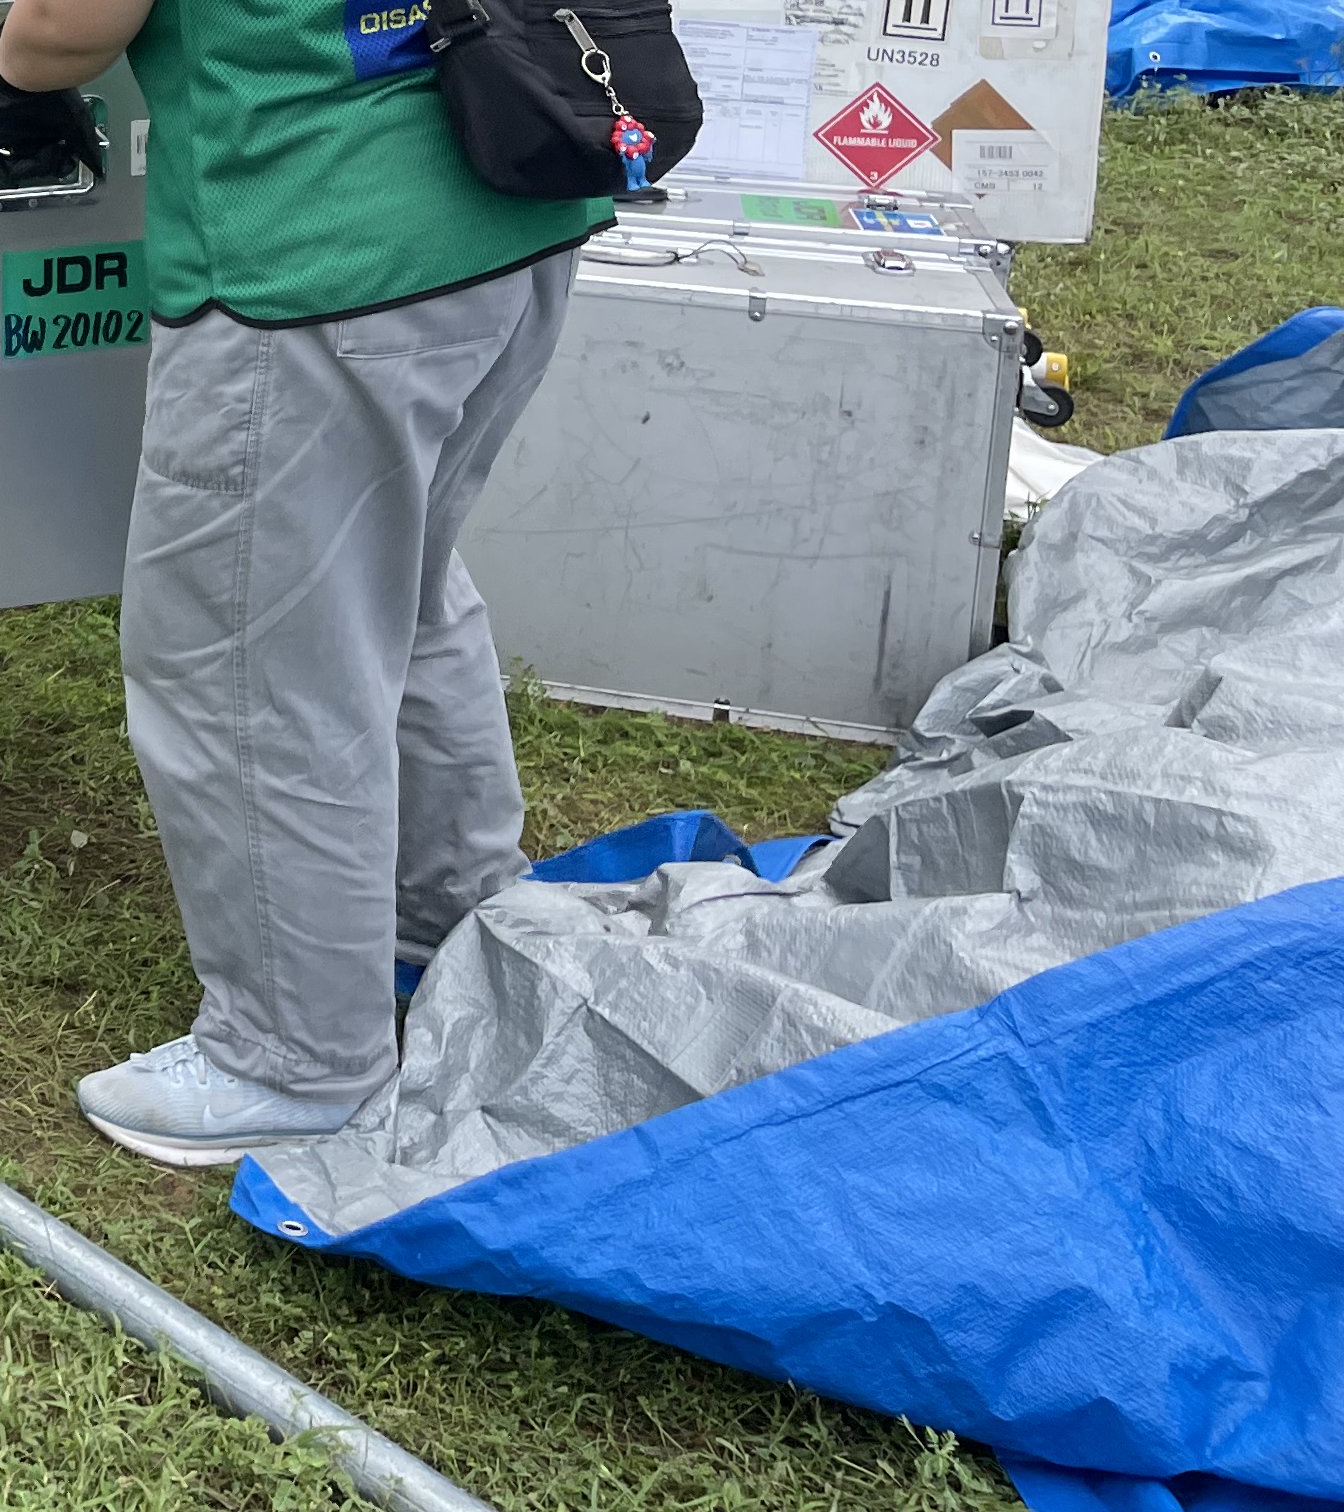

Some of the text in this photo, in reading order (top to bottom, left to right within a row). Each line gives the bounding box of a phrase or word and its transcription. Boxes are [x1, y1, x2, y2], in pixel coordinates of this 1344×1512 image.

[867, 46, 940, 67] UN3528
[833, 136, 917, 149] FLAMMABLE LIQUID
[870, 172, 878, 181] 3
[23, 252, 128, 297] JDR
